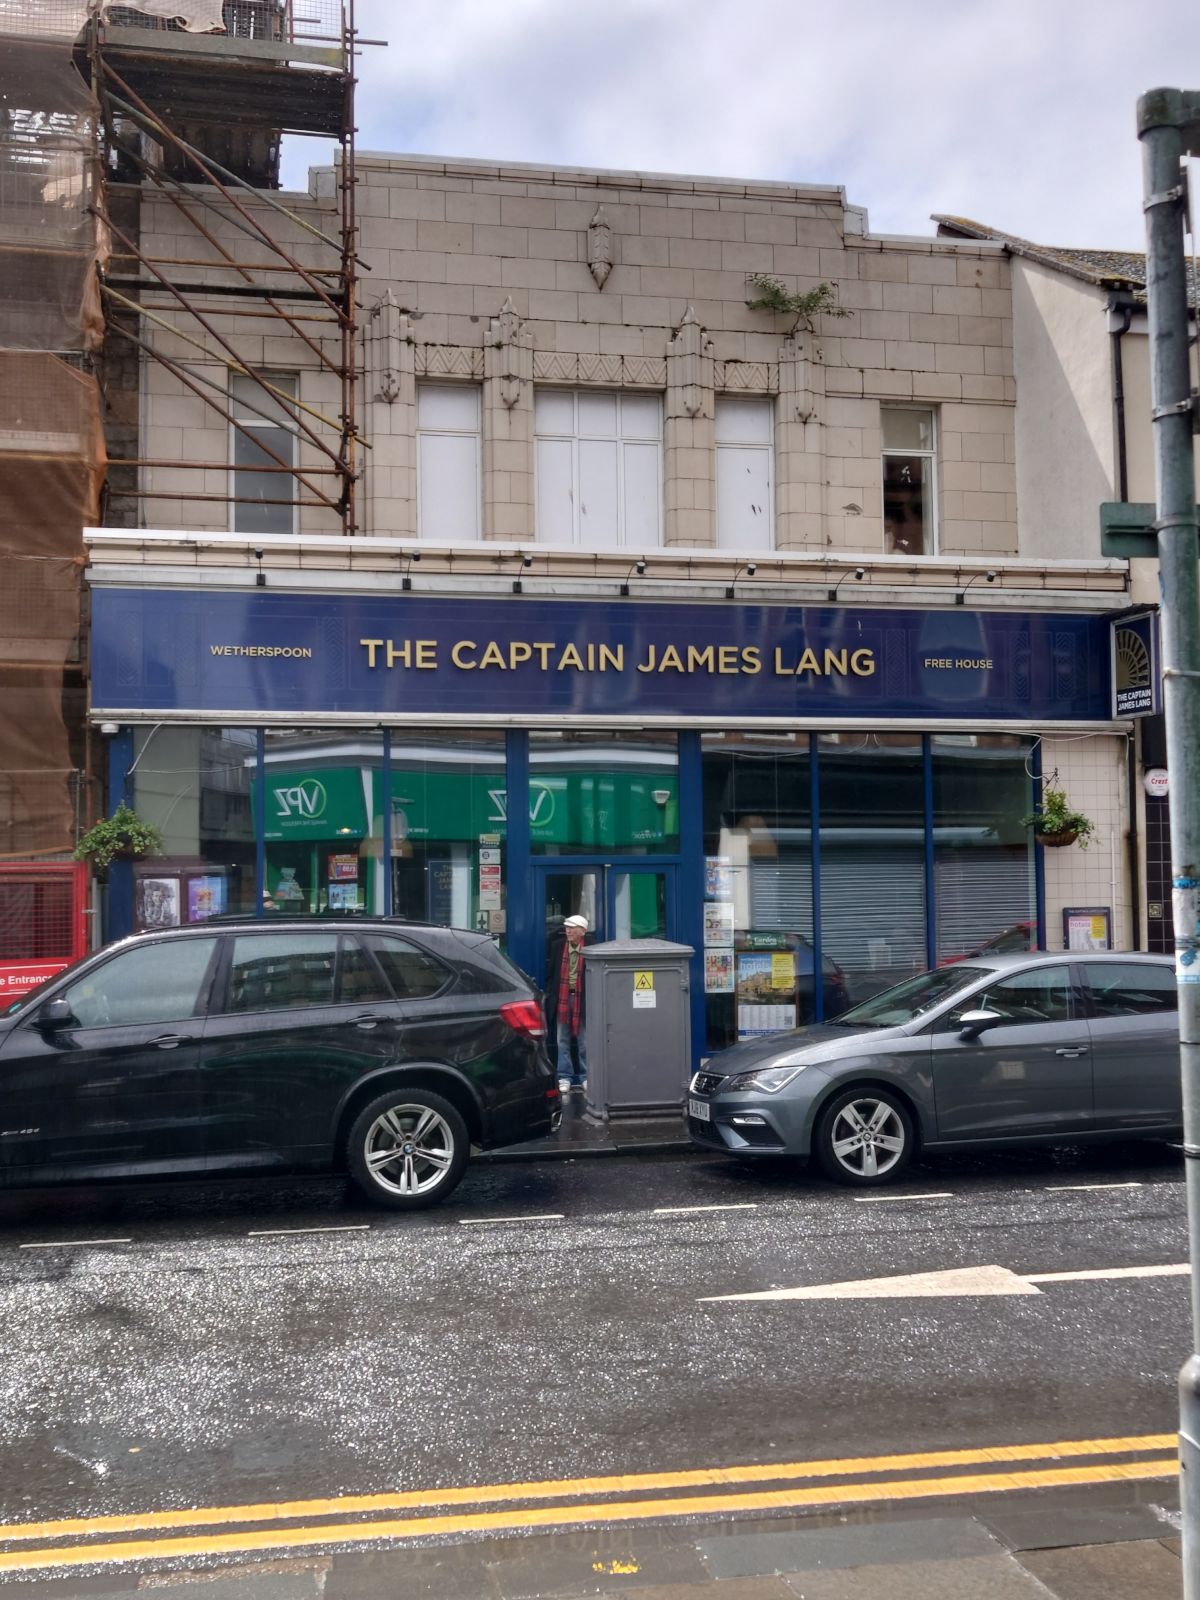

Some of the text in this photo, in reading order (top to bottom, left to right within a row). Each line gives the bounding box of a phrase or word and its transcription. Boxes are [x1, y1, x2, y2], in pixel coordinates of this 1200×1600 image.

[210, 645, 312, 658] WETHERSPOON
[360, 639, 876, 677] THE CAPTAIN JAMES LANG
[924, 658, 993, 669] FREE HOUSE
[1117, 689, 1151, 701] THE CAPTAIN
[1118, 698, 1151, 710] JAMES LANG
